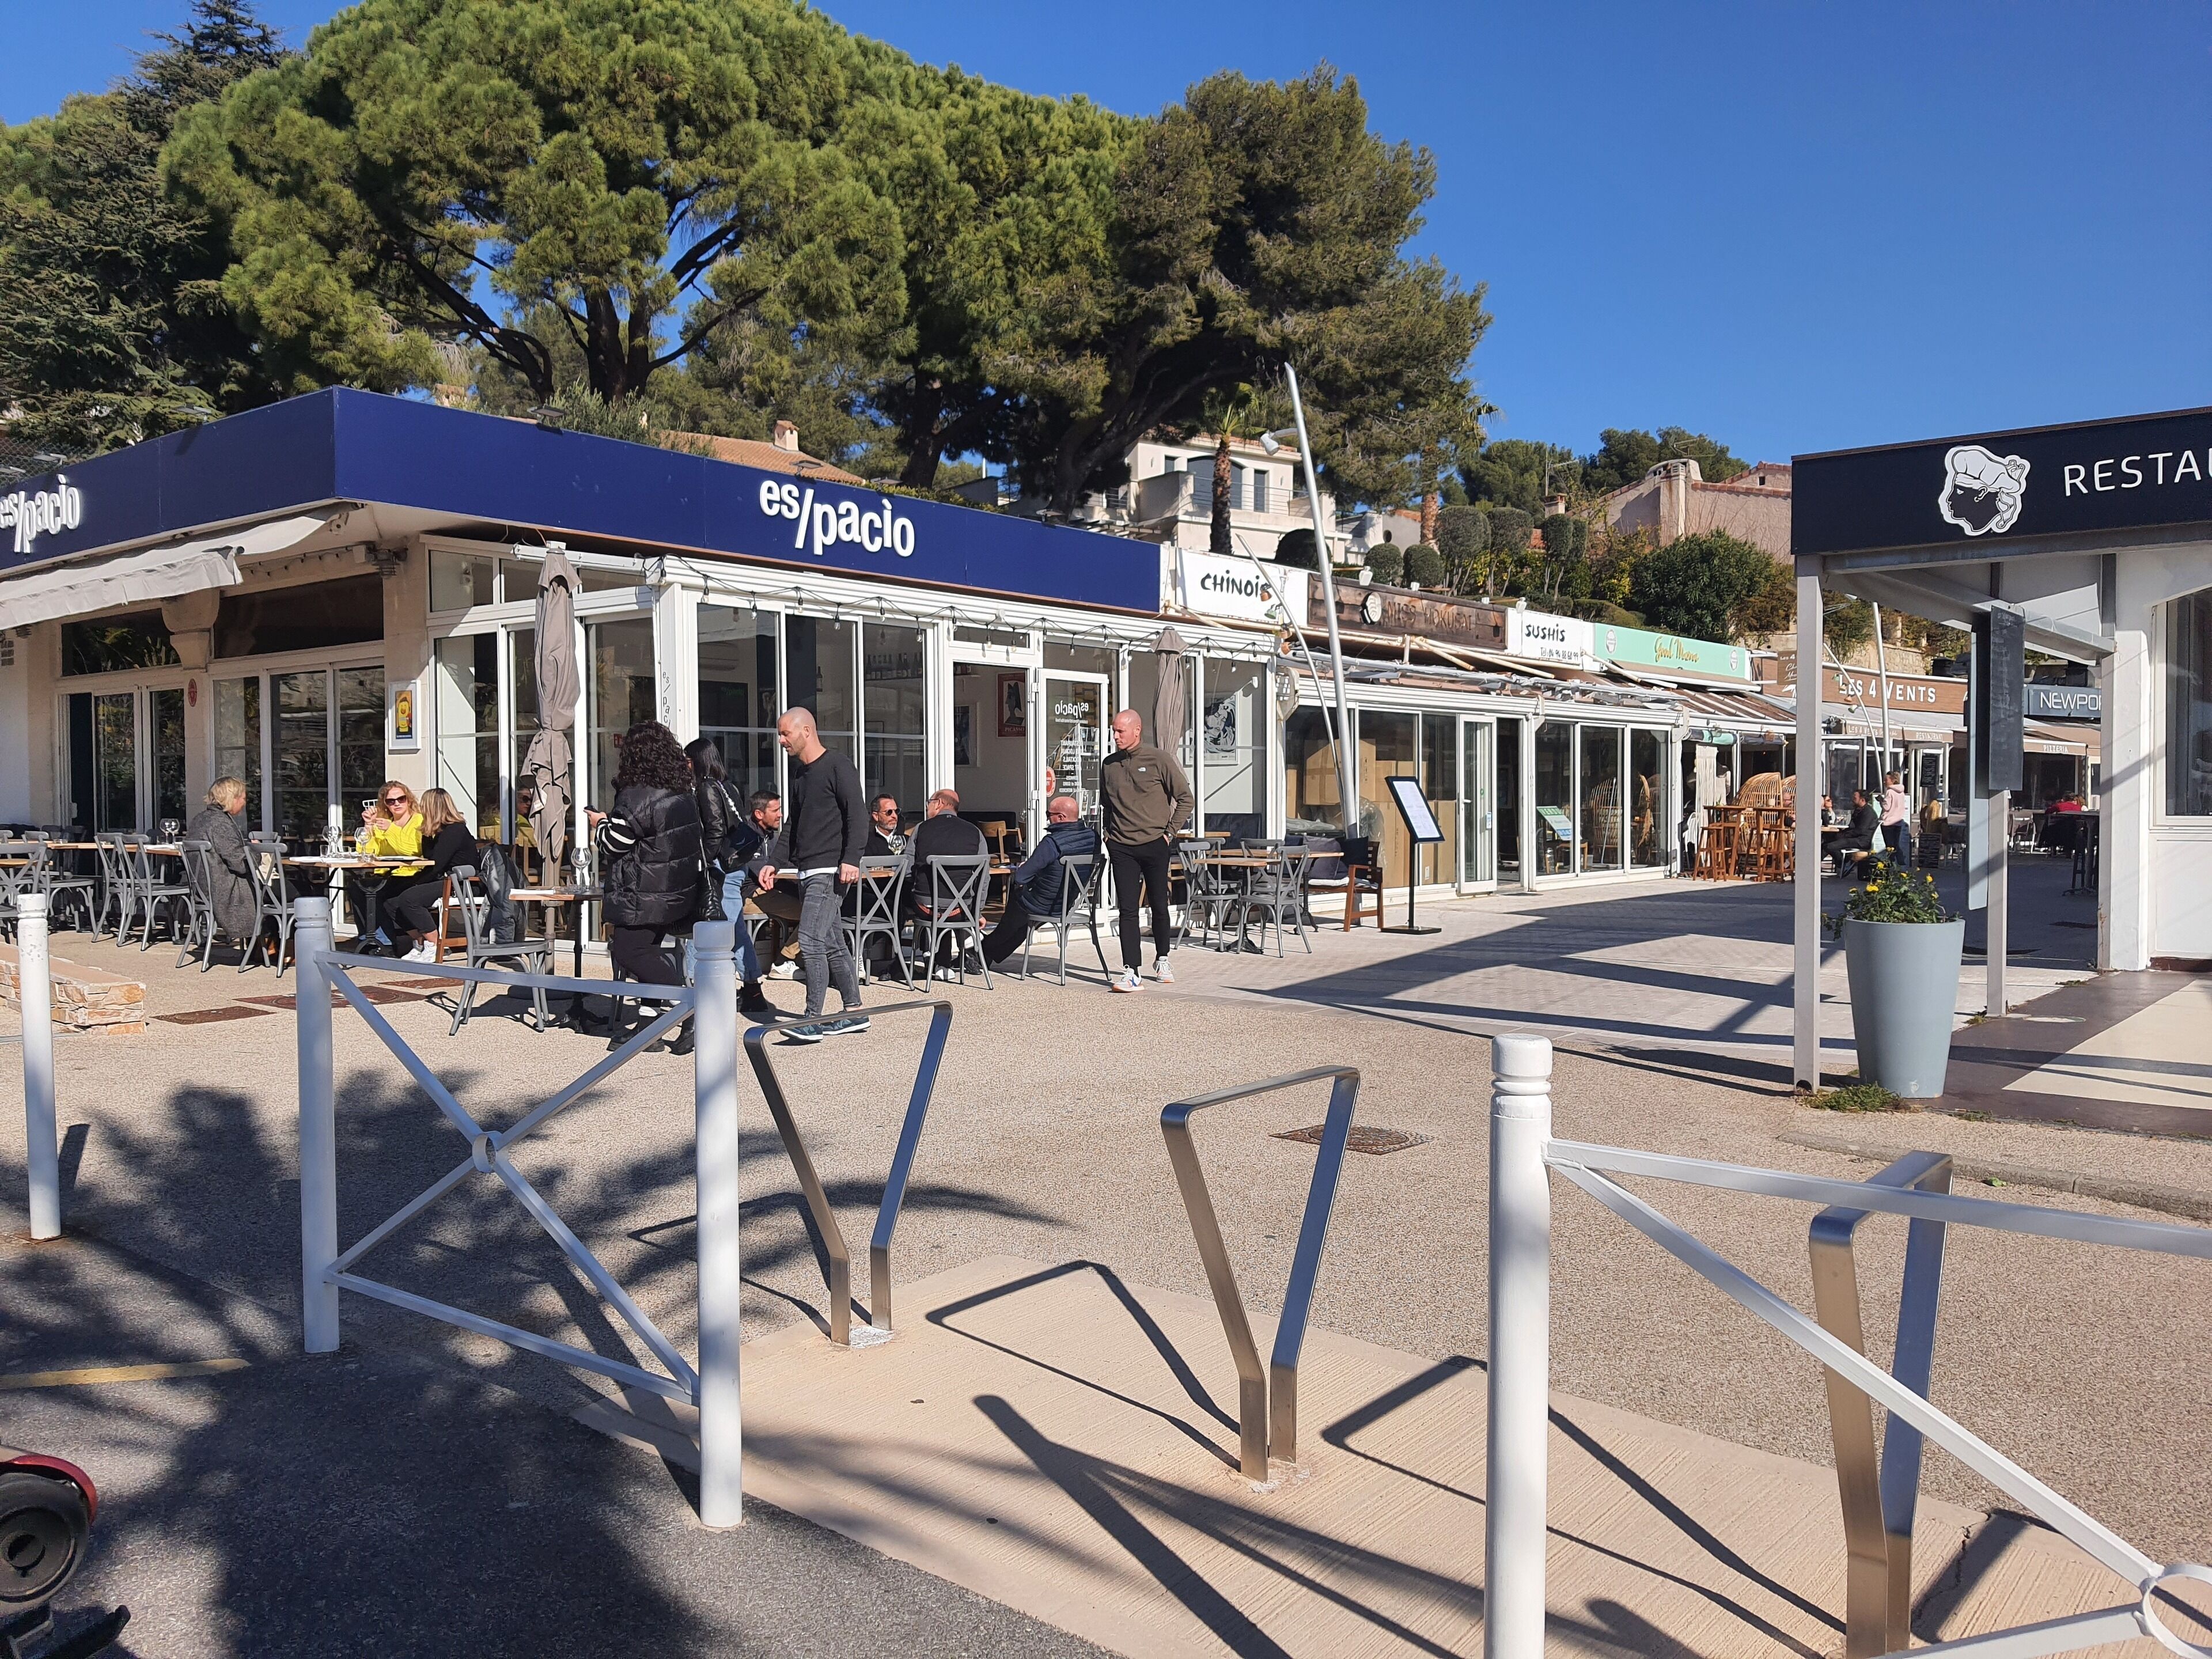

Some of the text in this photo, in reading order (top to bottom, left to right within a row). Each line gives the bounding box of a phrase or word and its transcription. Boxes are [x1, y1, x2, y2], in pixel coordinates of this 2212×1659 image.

[2064, 448, 2212, 497] RESTA
[1387, 601, 1472, 632] MISS HOKUSAI
[1869, 679, 1877, 698] 4
[1886, 681, 1936, 703] VENTS
[2040, 691, 2101, 711] NEWPO
[1916, 732, 1943, 741] RESTAURANT
[2043, 744, 2069, 753] PIZZERIA
